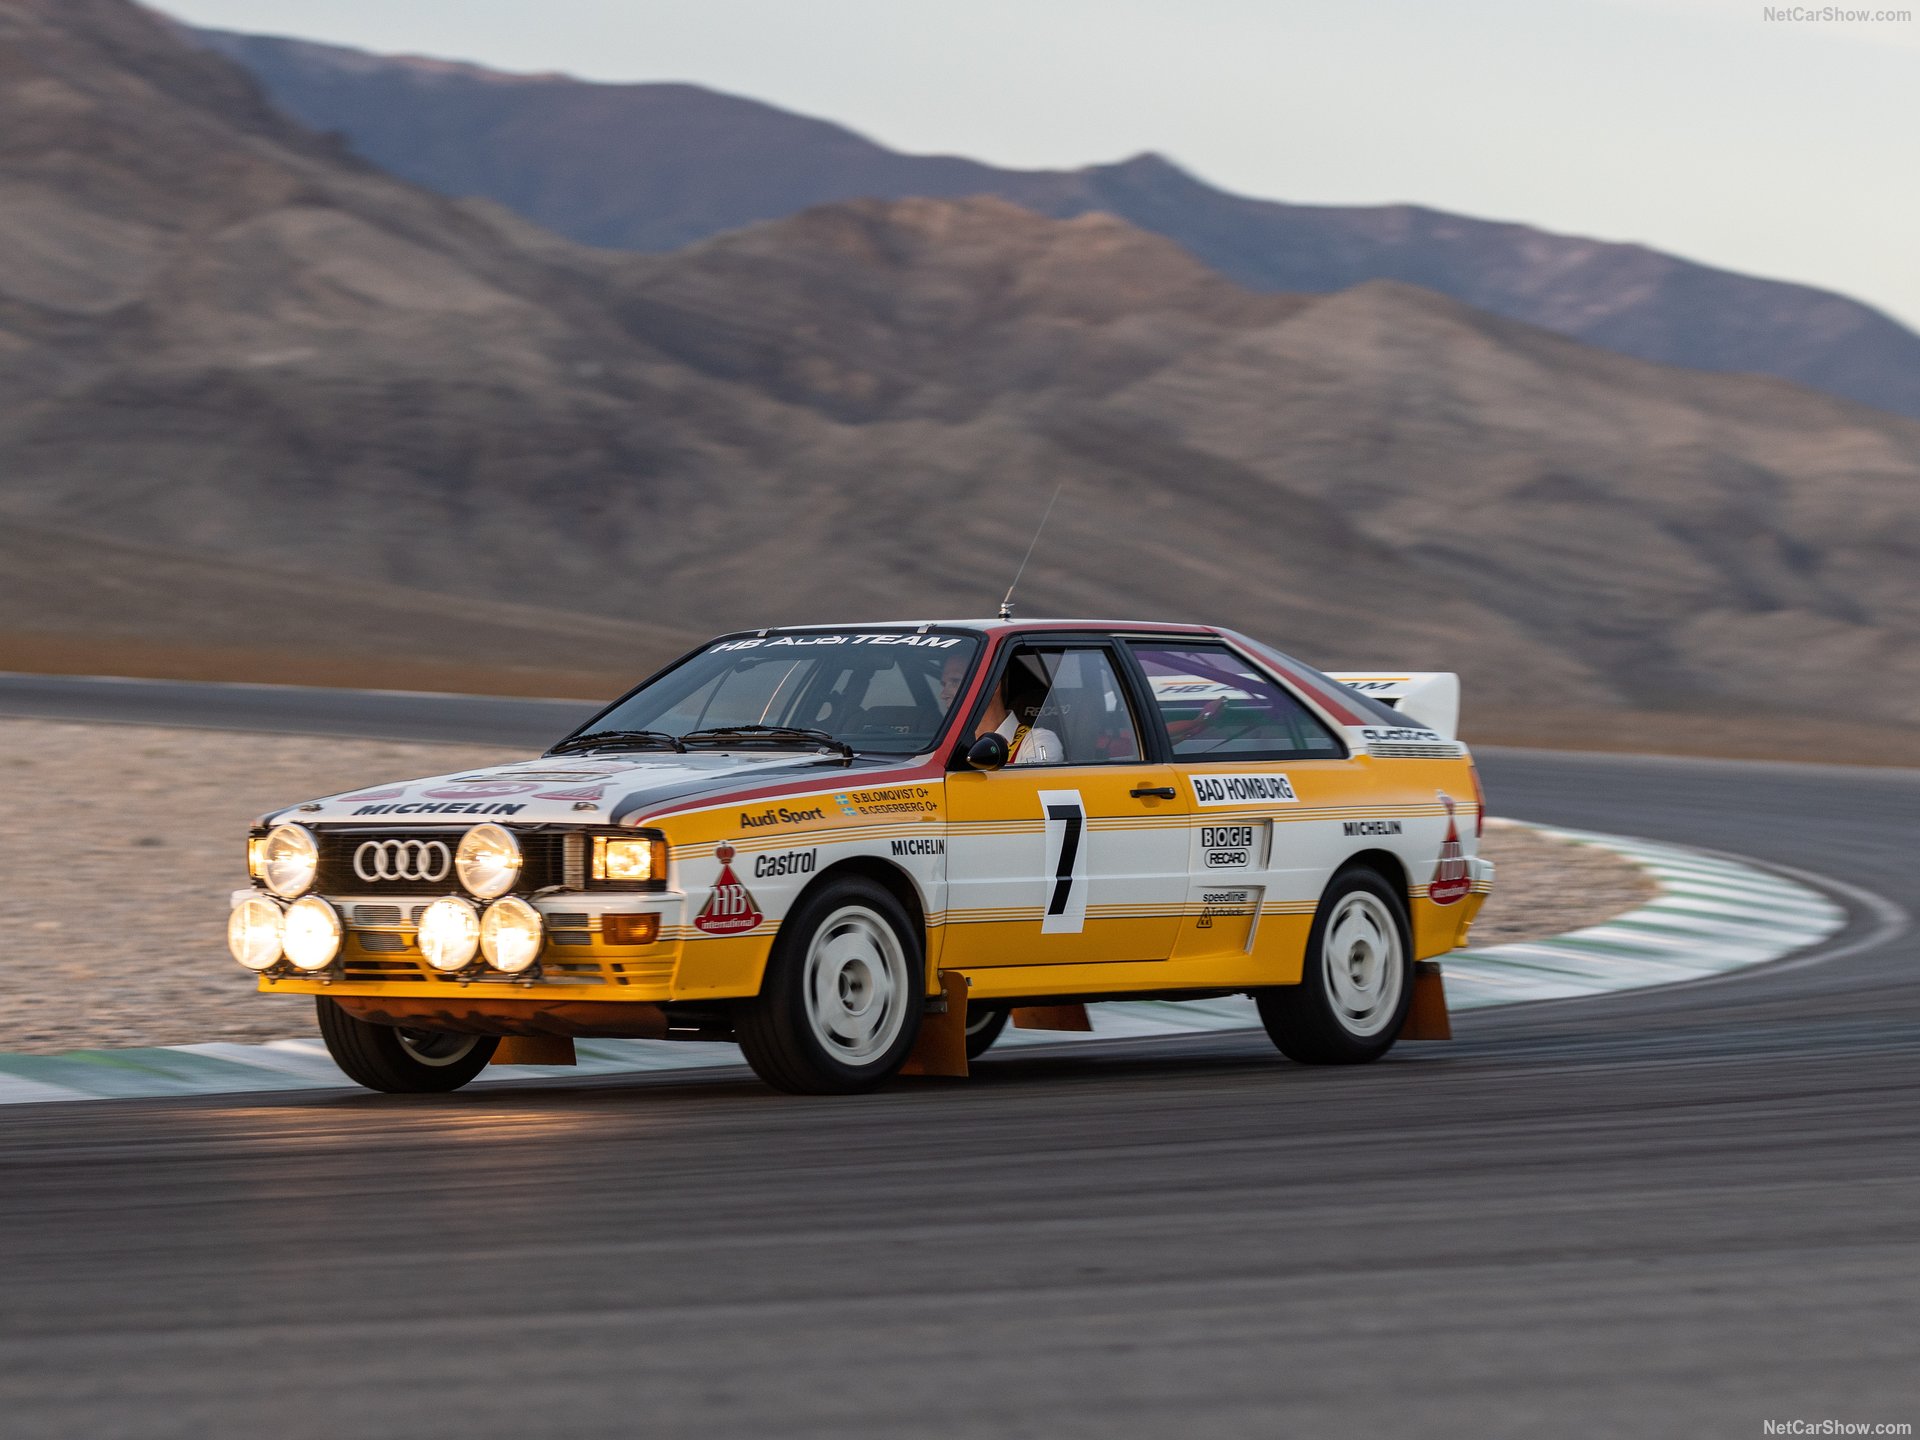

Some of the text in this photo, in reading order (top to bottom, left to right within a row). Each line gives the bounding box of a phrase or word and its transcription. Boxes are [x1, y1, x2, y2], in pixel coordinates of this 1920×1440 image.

[710, 639, 767, 654] HB
[851, 634, 962, 649] TEAM
[1157, 685, 1213, 694] HB
[852, 789, 914, 803] S.BLOMQVIST
[1193, 777, 1294, 802] BAD HOMBURG
[351, 802, 527, 816] MICHELIN
[740, 807, 825, 829] Audi Sport
[860, 803, 924, 815] B.CEDERBERG
[1202, 826, 1252, 848] BOGE
[1343, 820, 1402, 837] MICHELIN
[891, 839, 945, 856] MICHELIN
[754, 848, 818, 879] Castrol
[1046, 804, 1083, 916] 7
[1209, 851, 1247, 865] RECARO
[710, 883, 747, 916] HB
